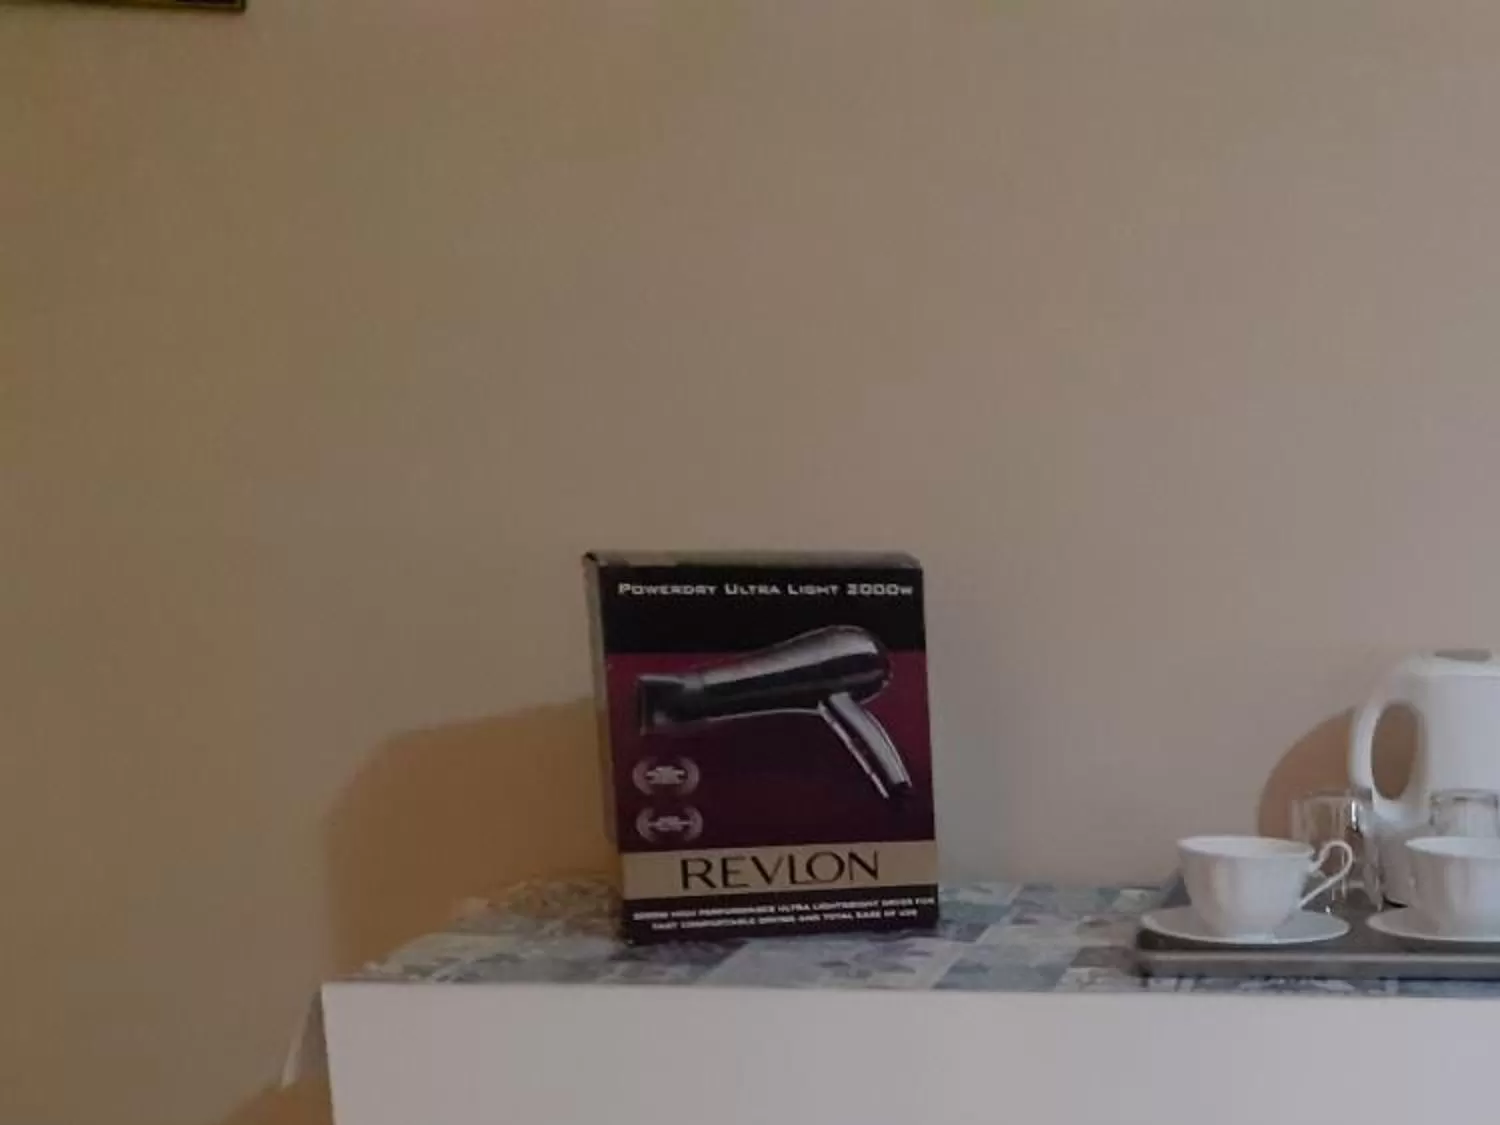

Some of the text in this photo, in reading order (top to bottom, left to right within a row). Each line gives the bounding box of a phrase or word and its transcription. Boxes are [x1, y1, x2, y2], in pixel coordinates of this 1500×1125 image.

[617, 582, 717, 596] POWERDRY
[724, 582, 780, 596] ULTRA
[787, 582, 839, 596] LIGHT
[680, 850, 880, 890] REVLON
[777, 902, 810, 913] ULTRA
